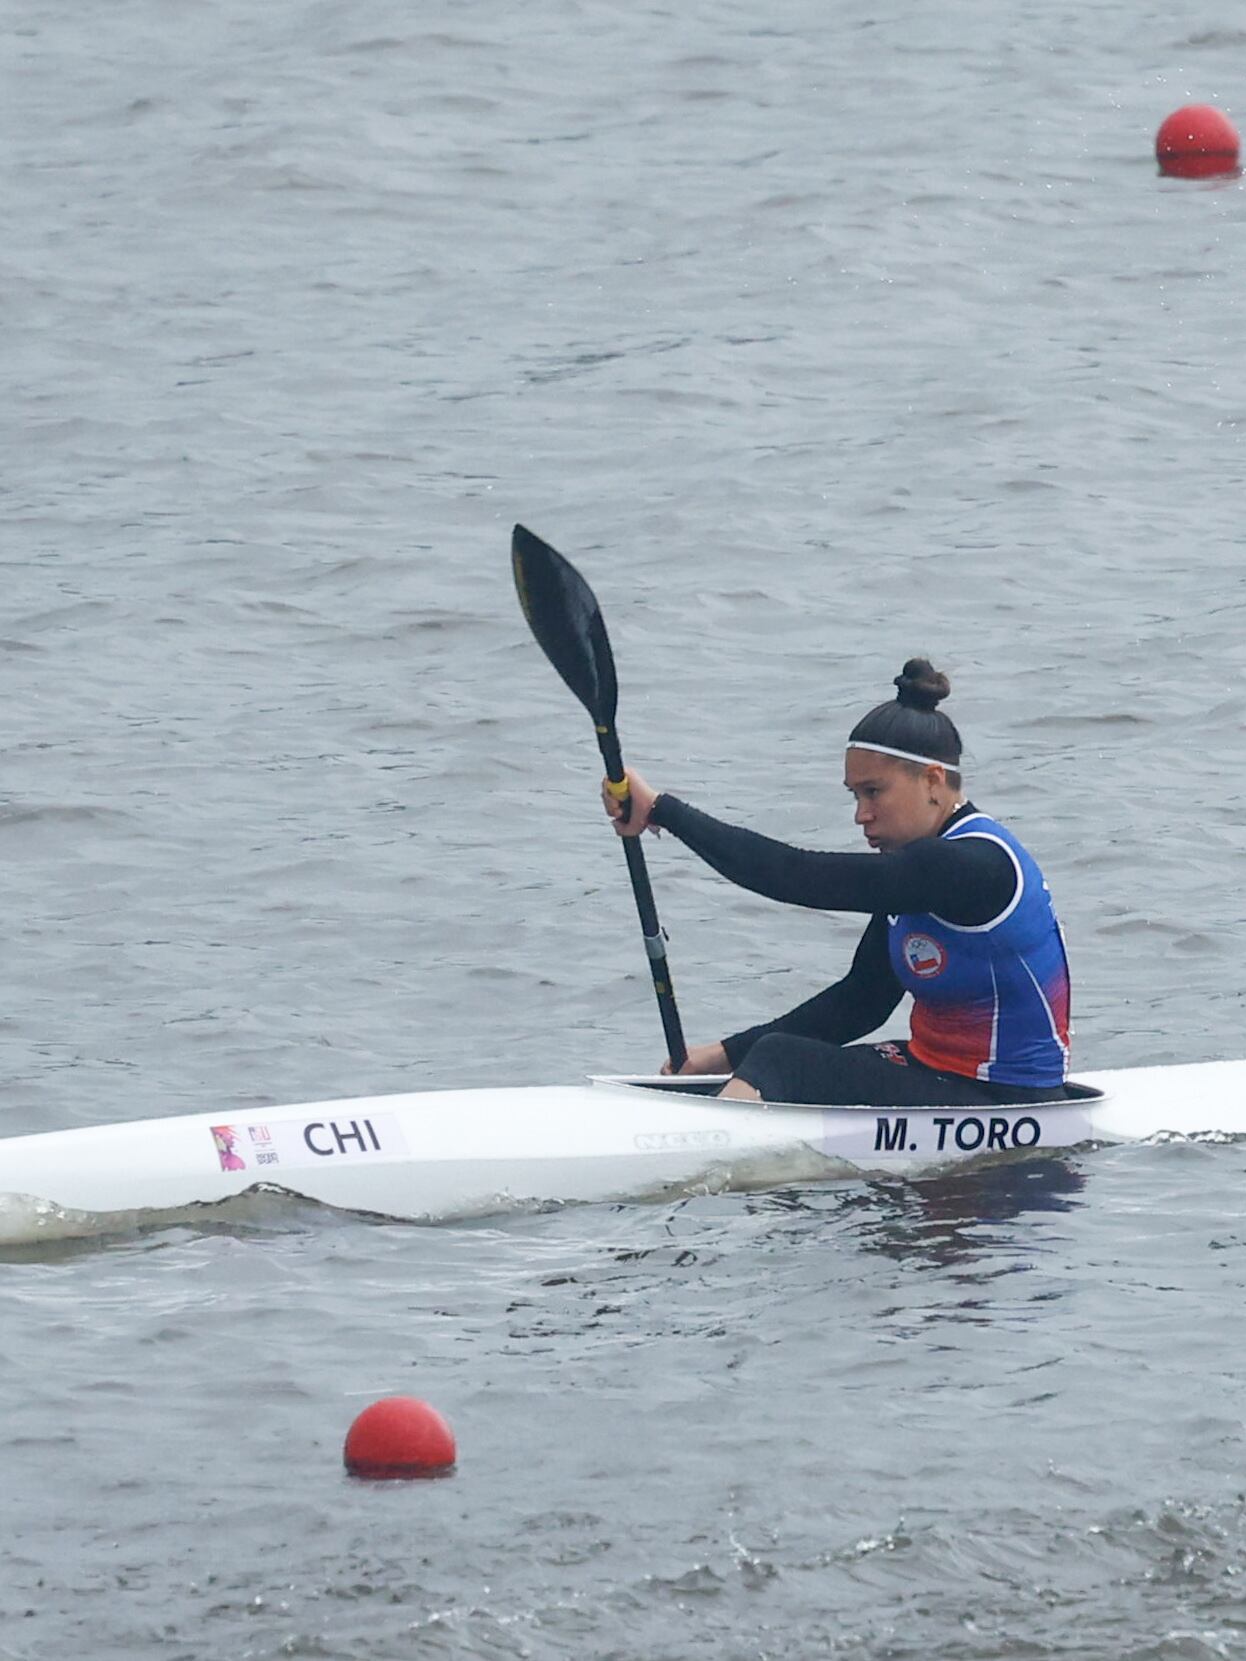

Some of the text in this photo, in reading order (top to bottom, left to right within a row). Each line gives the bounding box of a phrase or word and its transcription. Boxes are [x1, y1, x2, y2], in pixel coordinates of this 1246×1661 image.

[303, 1119, 382, 1157] CHI
[874, 1116, 1041, 1151] M. TORO
